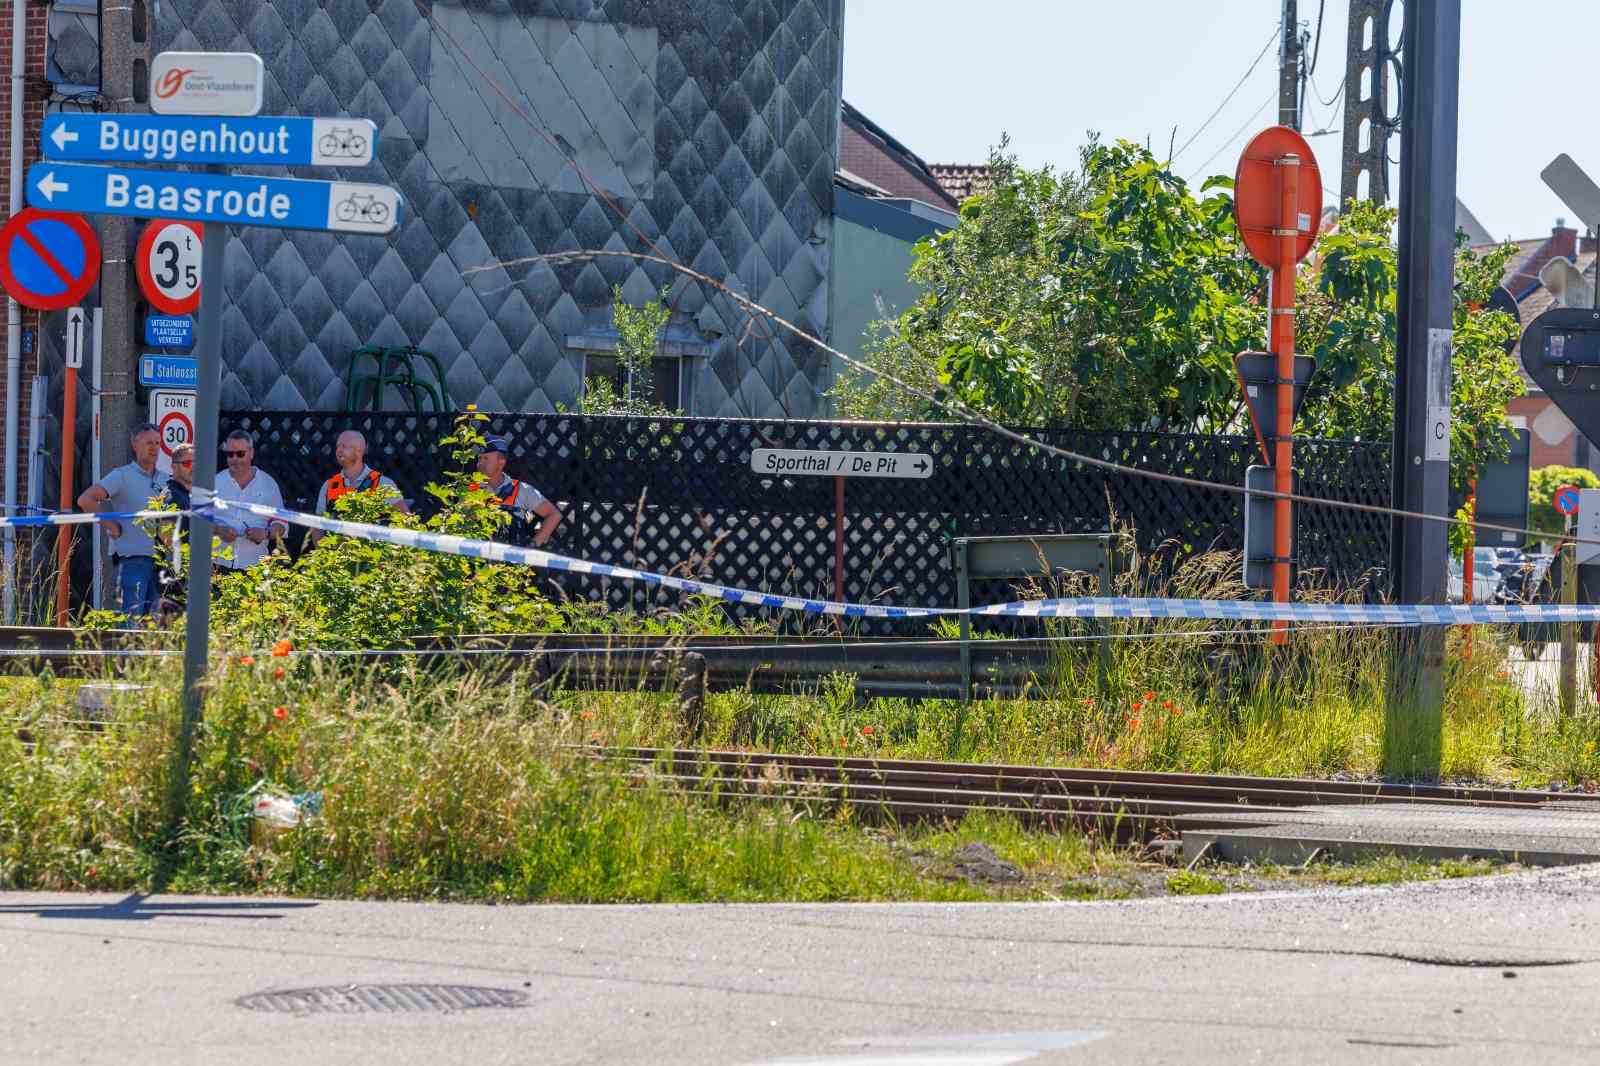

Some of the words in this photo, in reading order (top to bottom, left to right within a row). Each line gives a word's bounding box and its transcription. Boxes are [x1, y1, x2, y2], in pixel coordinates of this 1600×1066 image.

[99, 120, 289, 159] Buggenhout
[105, 173, 291, 220] Baasrode
[164, 398, 189, 408] ZONE
[166, 426, 185, 443] 30
[1435, 421, 1445, 440] C
[766, 454, 831, 472] Sporthal
[852, 457, 872, 472] De
[876, 457, 897, 473] Pit
